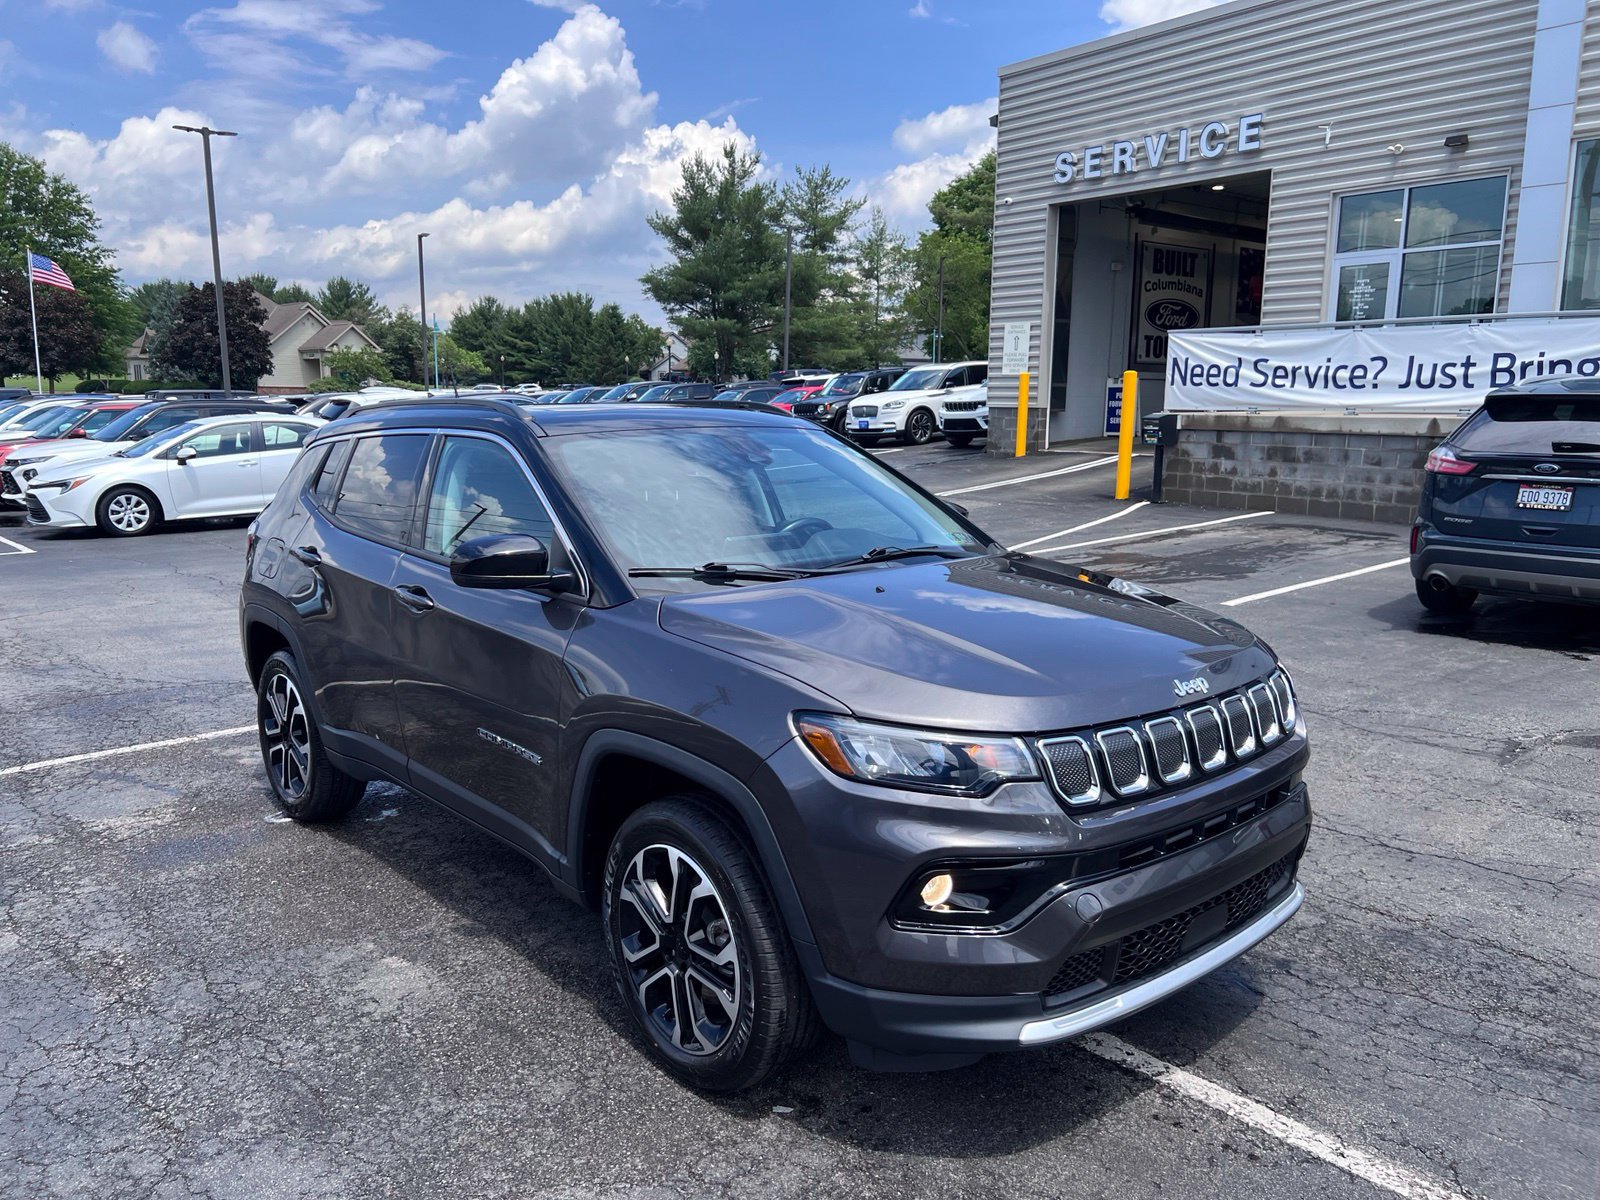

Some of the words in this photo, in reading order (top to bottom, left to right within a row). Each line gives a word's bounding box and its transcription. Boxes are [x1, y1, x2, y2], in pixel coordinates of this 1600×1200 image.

[1054, 112, 1263, 185] SERVICE
[1152, 248, 1199, 278] BUILT
[1144, 279, 1203, 298] Columbiana
[1155, 303, 1189, 327] Ford
[1170, 357, 1242, 387] Need
[1249, 356, 1388, 389] Service?
[1398, 355, 1477, 389] Just
[1543, 491, 1569, 505] 9378
[1173, 677, 1210, 697] Jeep
